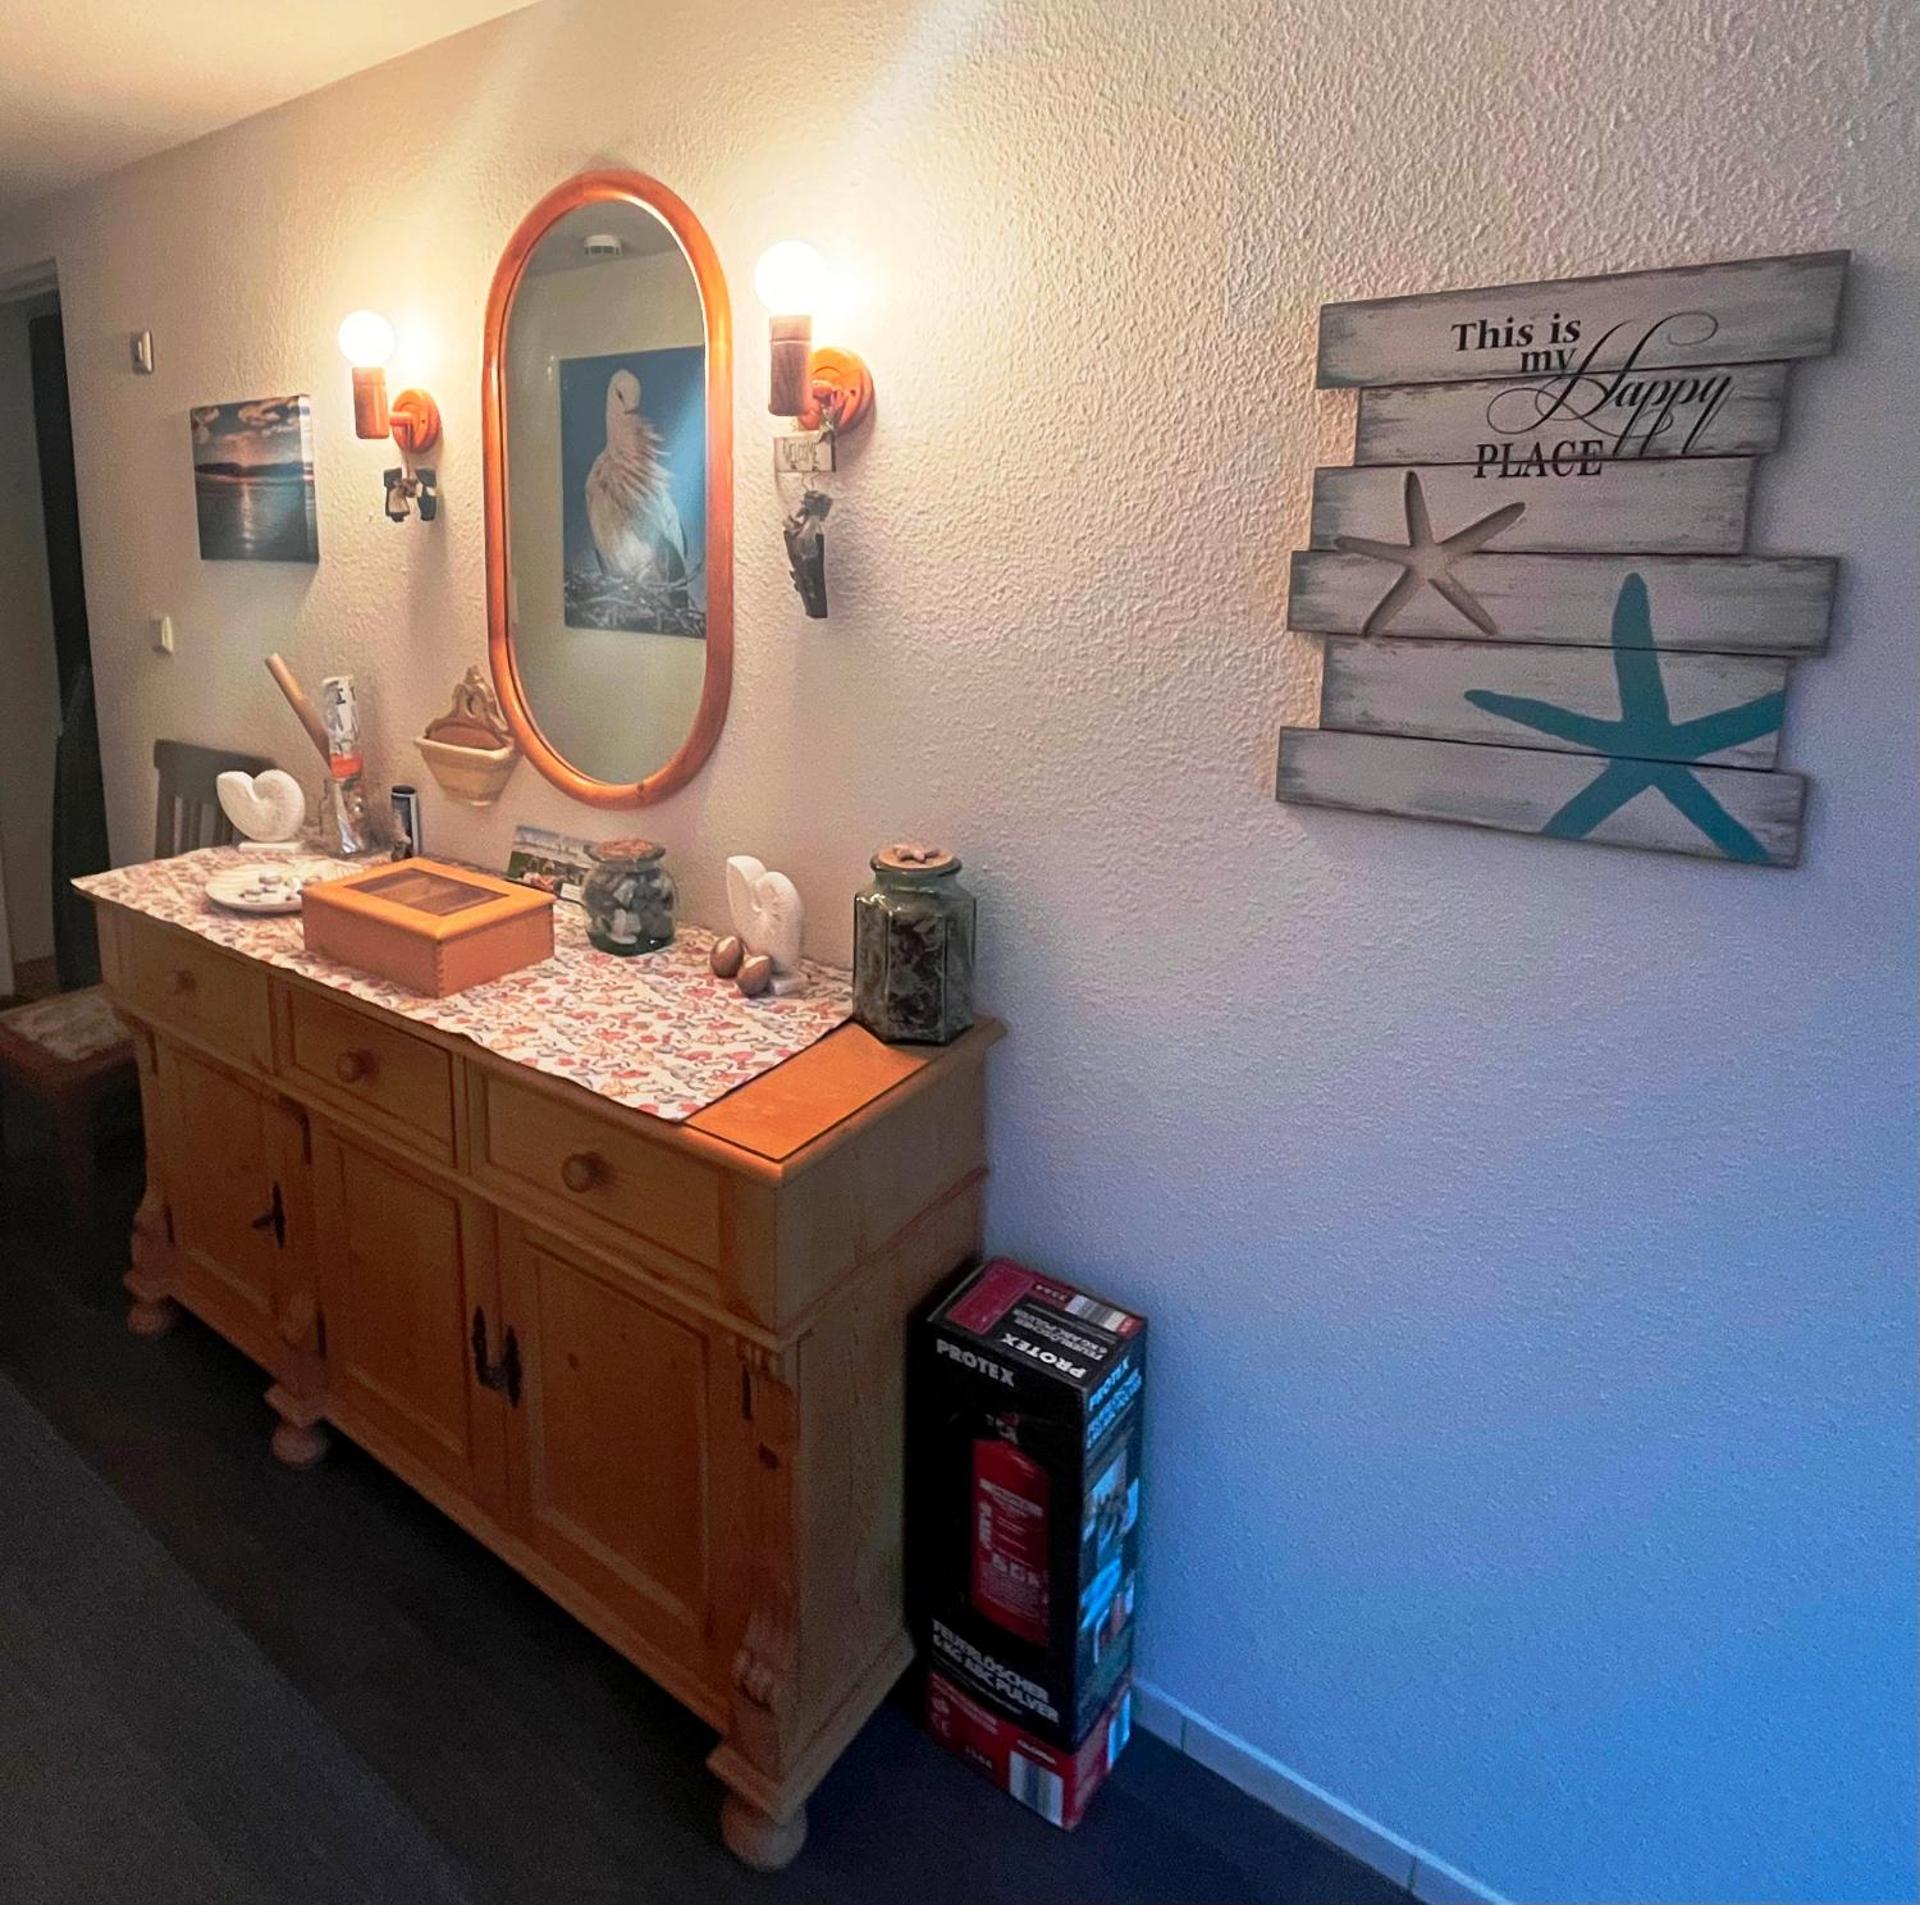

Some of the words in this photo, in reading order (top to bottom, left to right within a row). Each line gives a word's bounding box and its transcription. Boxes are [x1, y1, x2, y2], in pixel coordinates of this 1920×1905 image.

[1451, 314, 1534, 352] This
[1550, 312, 1581, 344] is
[1520, 348, 1577, 373] my
[1486, 310, 1736, 457] Happy
[1473, 440, 1604, 478] PLACE
[936, 1339, 1015, 1387] PROTEX
[1001, 1333, 1087, 1378] PROTEX
